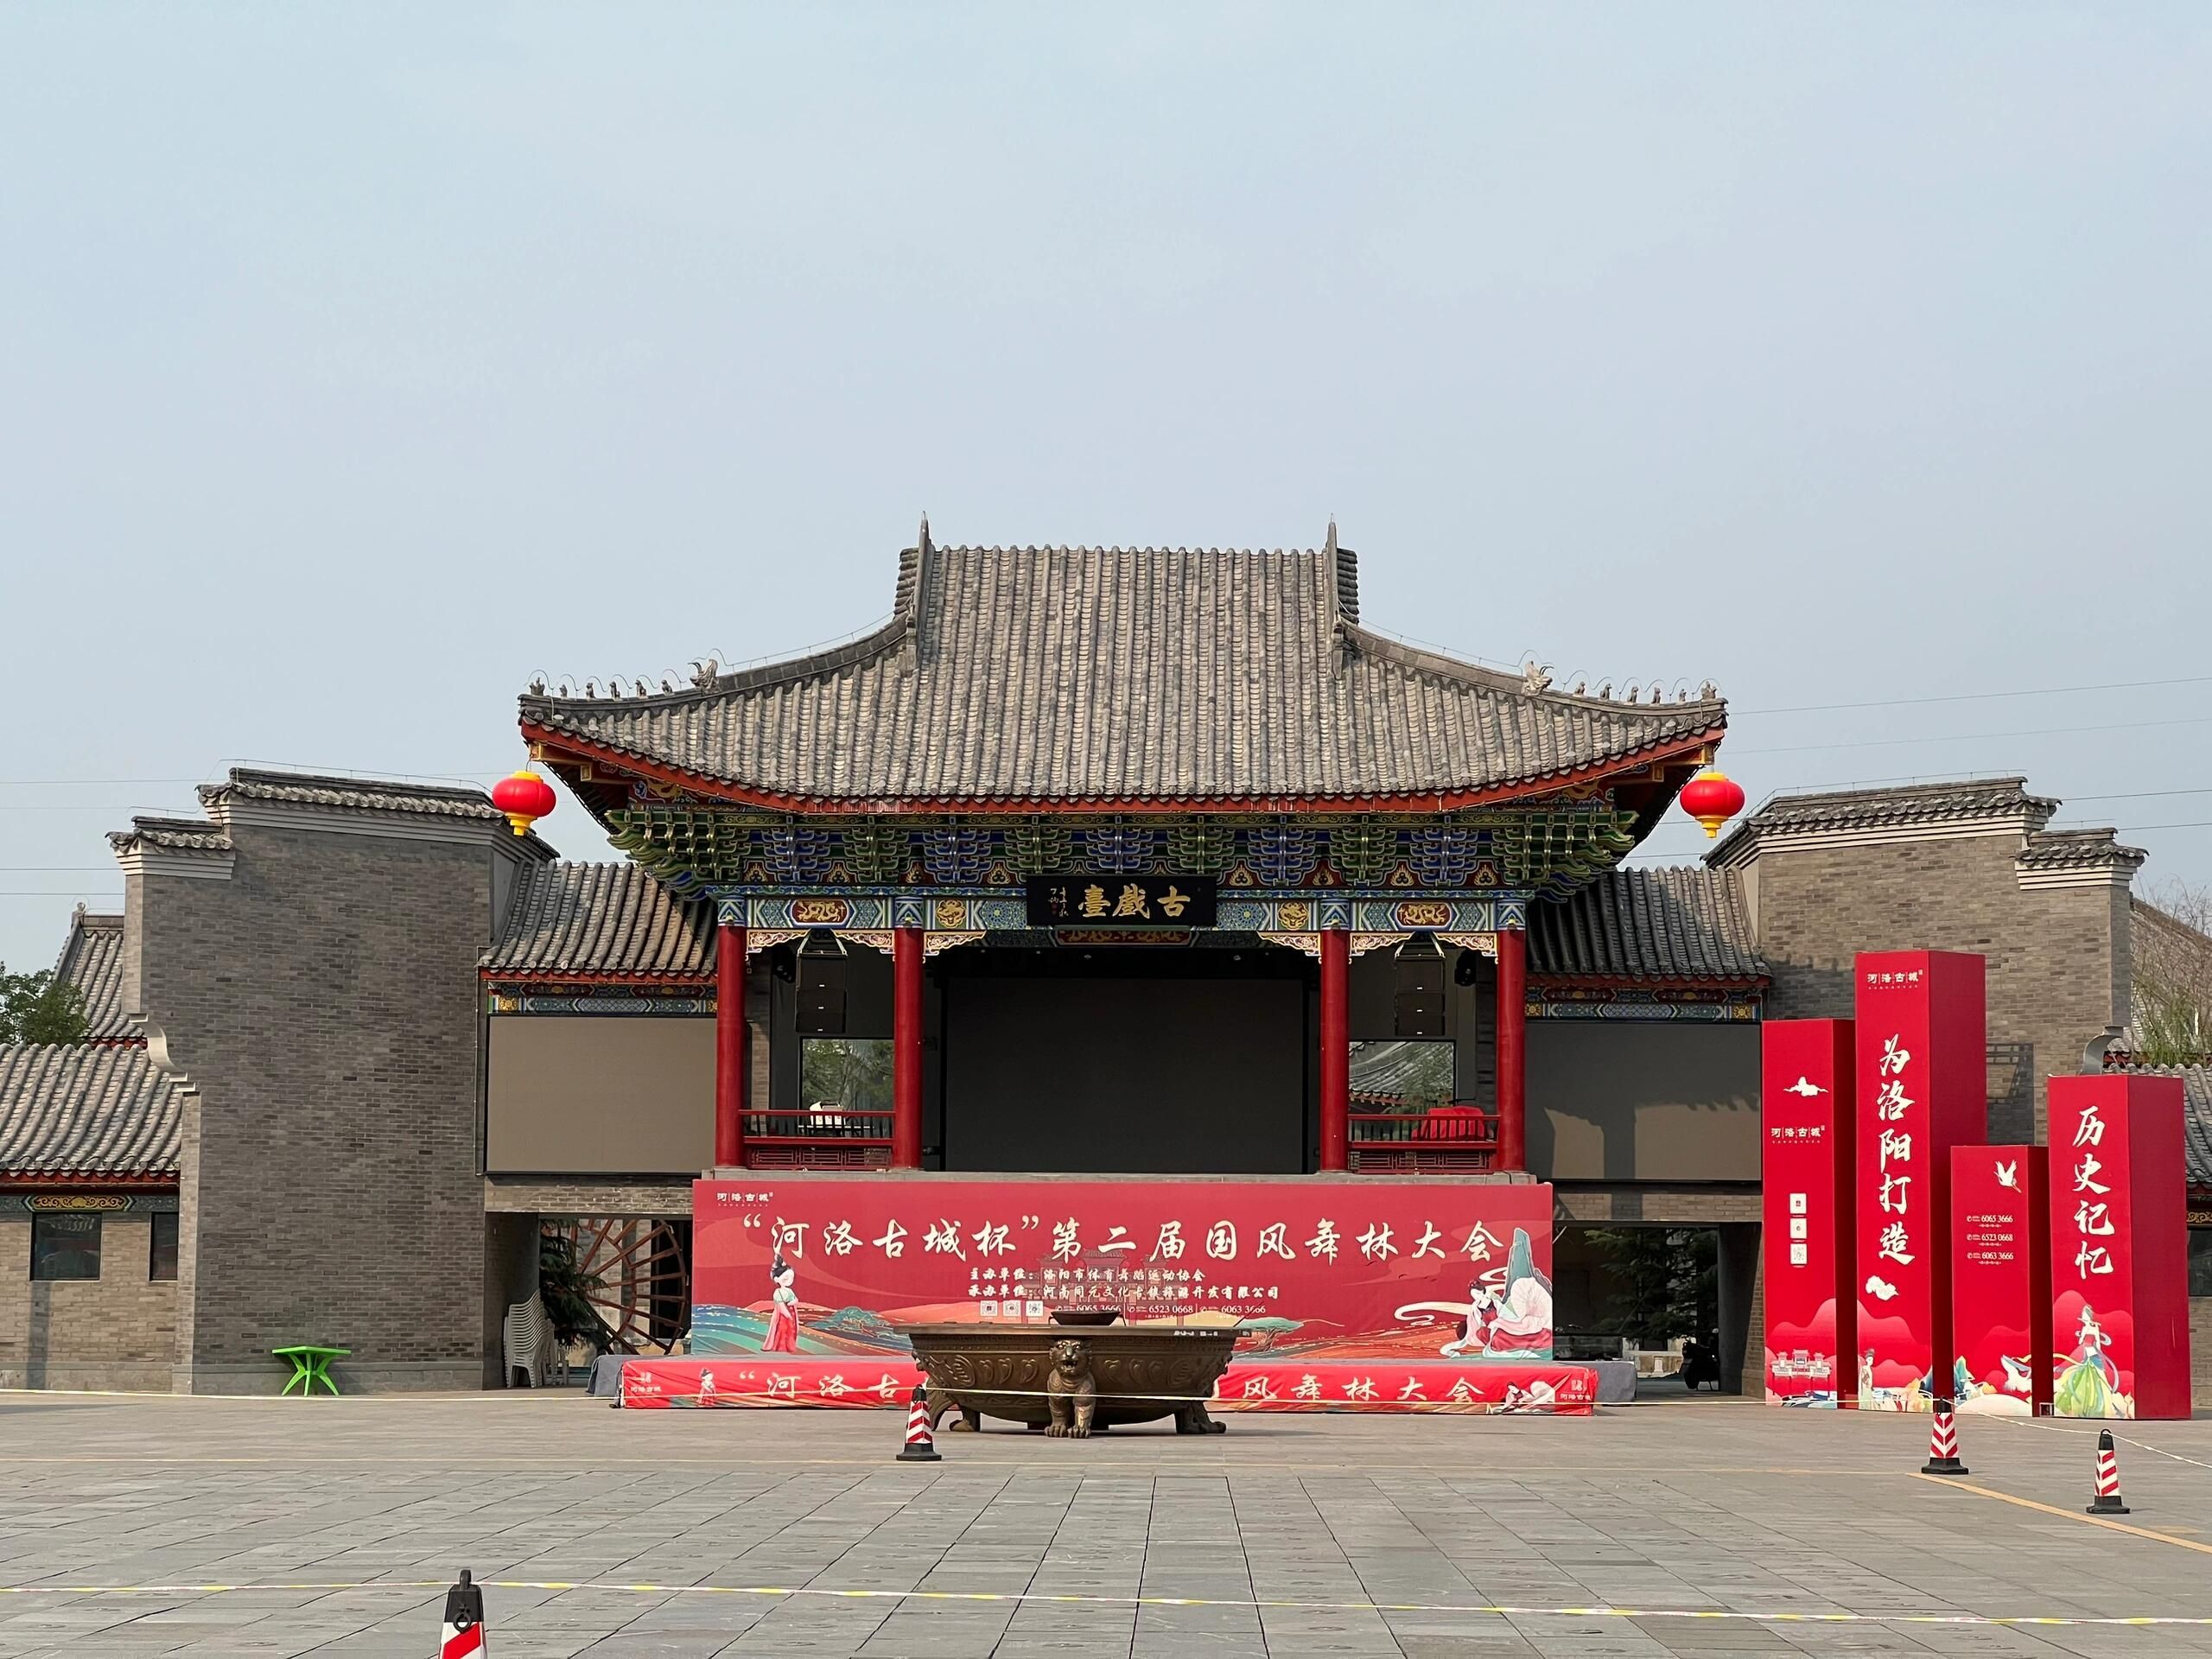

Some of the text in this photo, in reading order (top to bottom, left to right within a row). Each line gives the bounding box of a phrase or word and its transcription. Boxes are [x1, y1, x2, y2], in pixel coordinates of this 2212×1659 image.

[1876, 1033, 1916, 1266] 为洛阳打造
[2072, 1105, 2115, 1281] 历史记忆
[1980, 1215, 1997, 1224] 6065
[1997, 1215, 2013, 1224] 3666
[1980, 1233, 1997, 1242] 6523
[1997, 1233, 2014, 1242] 0668
[1981, 1251, 1998, 1260] 6063
[1998, 1251, 2015, 1260] 3666
[1148, 1305, 1170, 1313] 6523
[1172, 1305, 1194, 1313] 0668
[1221, 1305, 1243, 1313] 6063
[1212, 1373, 1484, 1403] 风舞林大会
